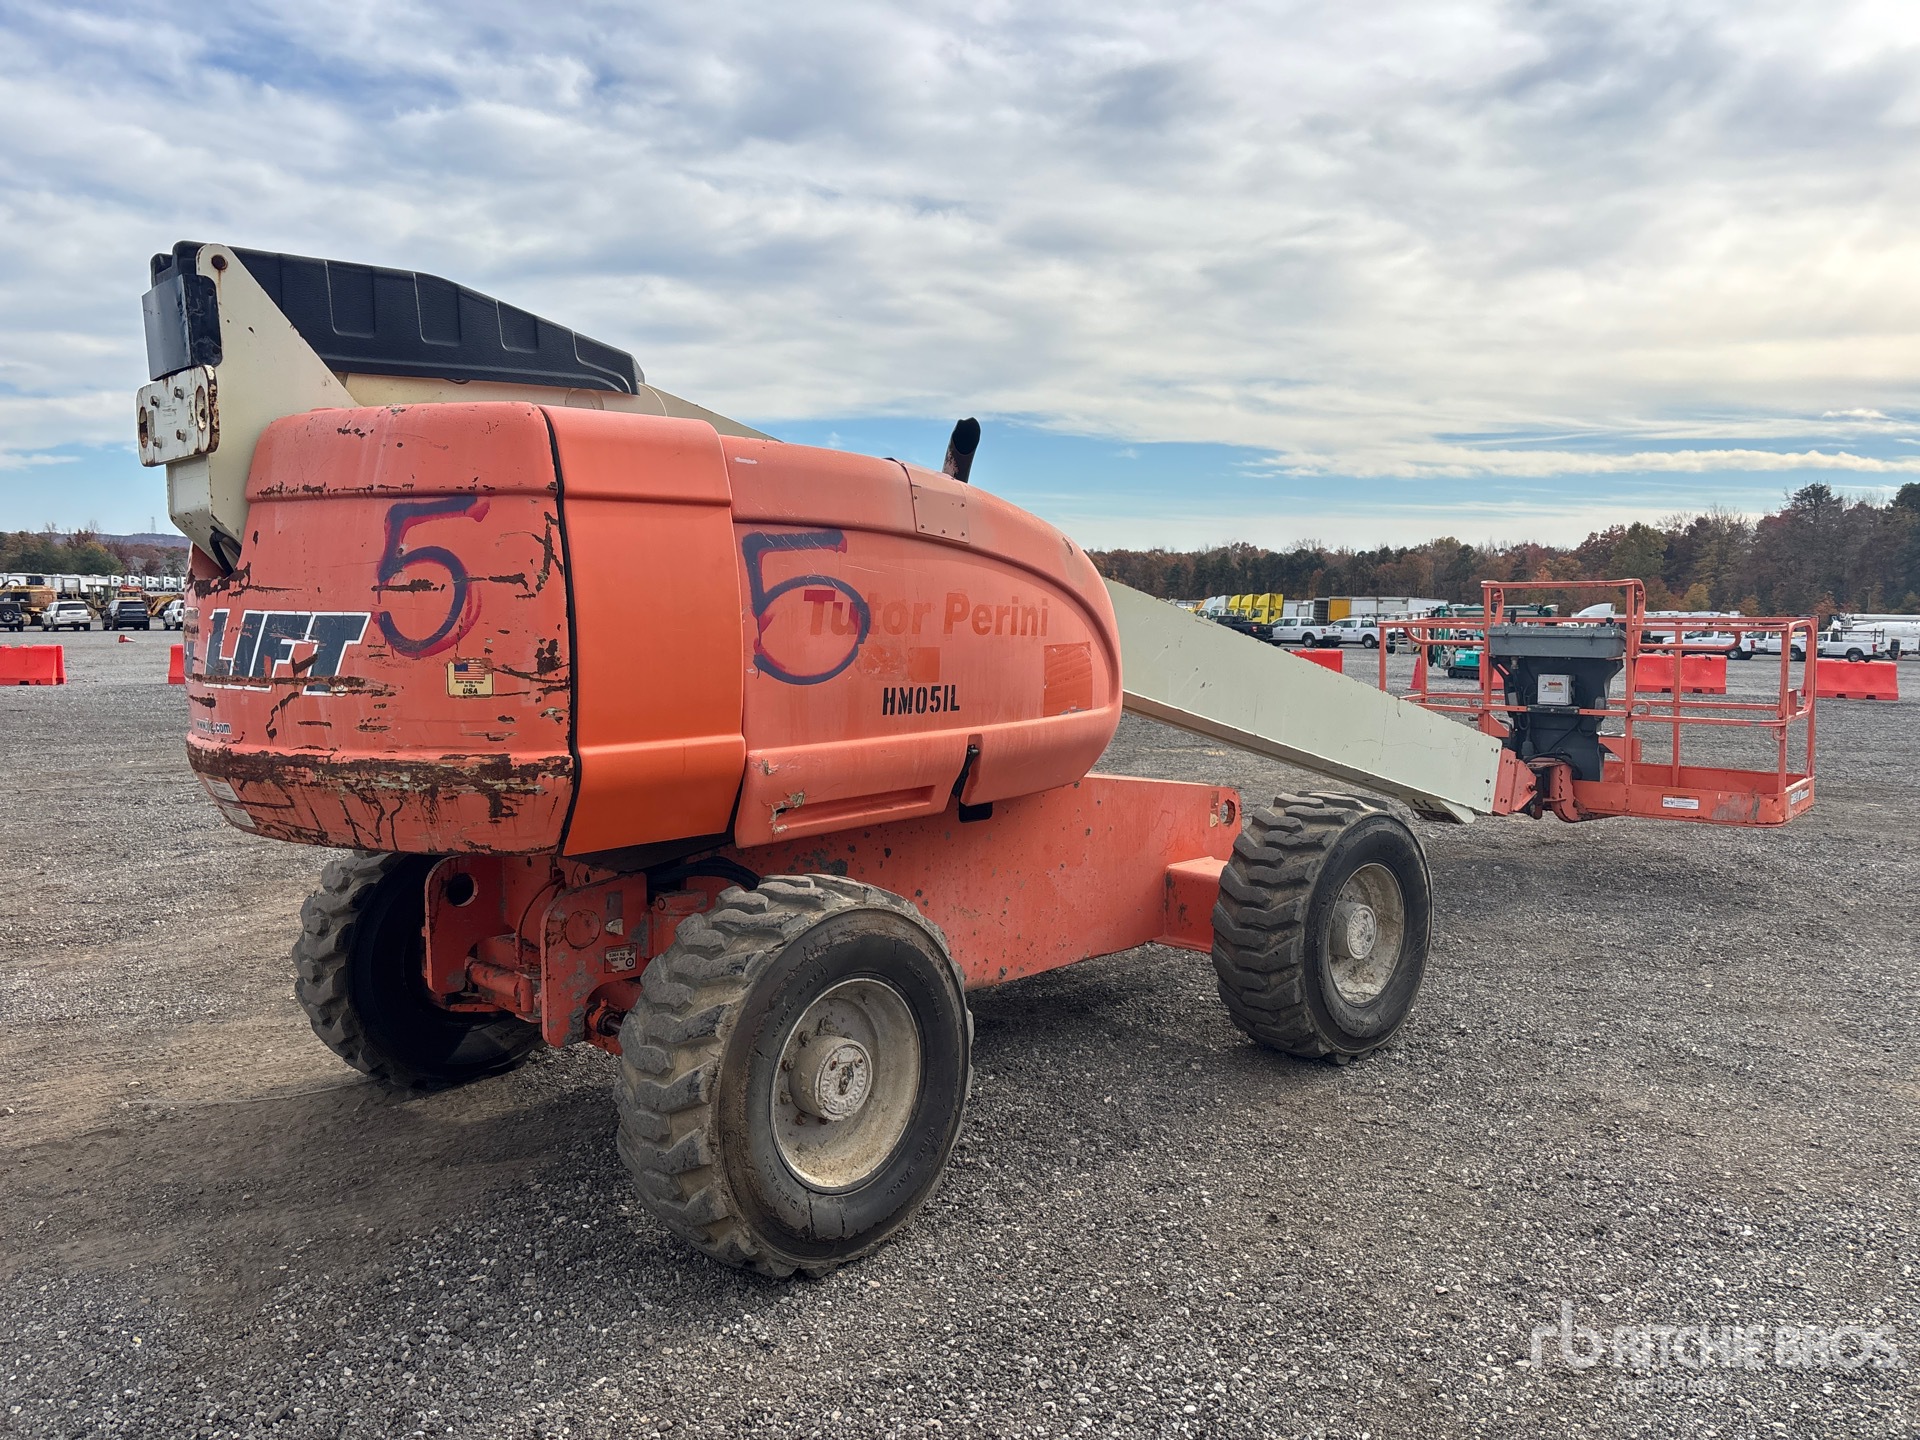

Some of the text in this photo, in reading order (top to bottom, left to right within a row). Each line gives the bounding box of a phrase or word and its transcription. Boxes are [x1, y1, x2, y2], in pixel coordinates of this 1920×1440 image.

[372, 493, 490, 659] 5
[741, 529, 871, 686] 5
[804, 589, 1049, 637] Tutor Perini
[203, 608, 372, 697] LIFT
